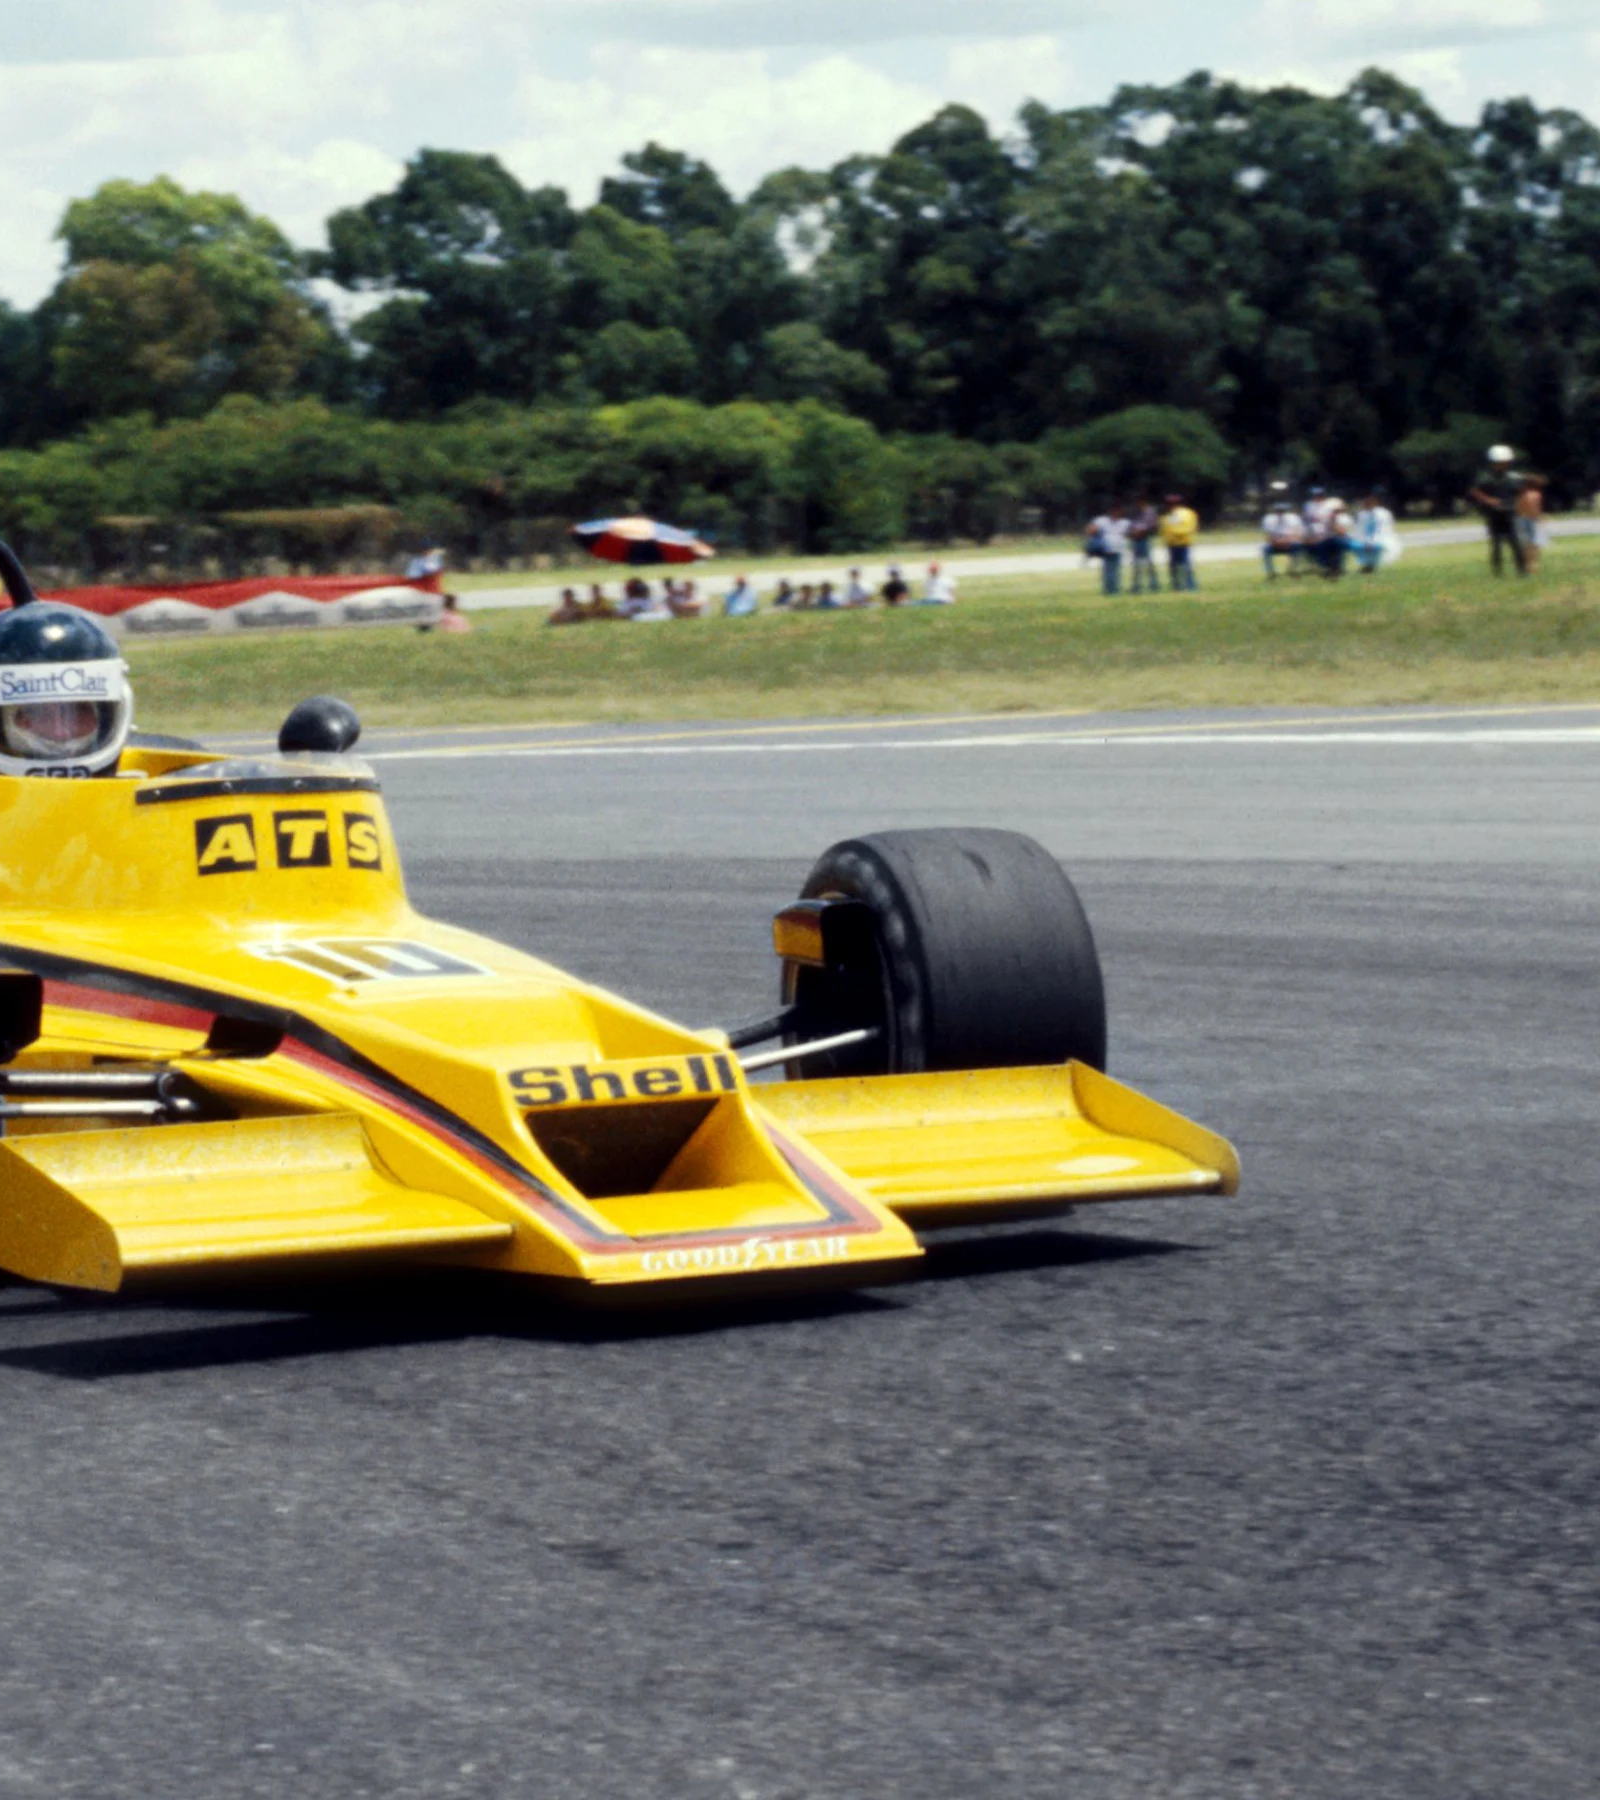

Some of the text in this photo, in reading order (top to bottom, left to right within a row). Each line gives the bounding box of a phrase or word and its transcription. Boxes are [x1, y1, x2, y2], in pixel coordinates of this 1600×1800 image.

[199, 817, 379, 871] ATS
[507, 1054, 738, 1107] Shell
[640, 1235, 849, 1271] GOODYEAR
